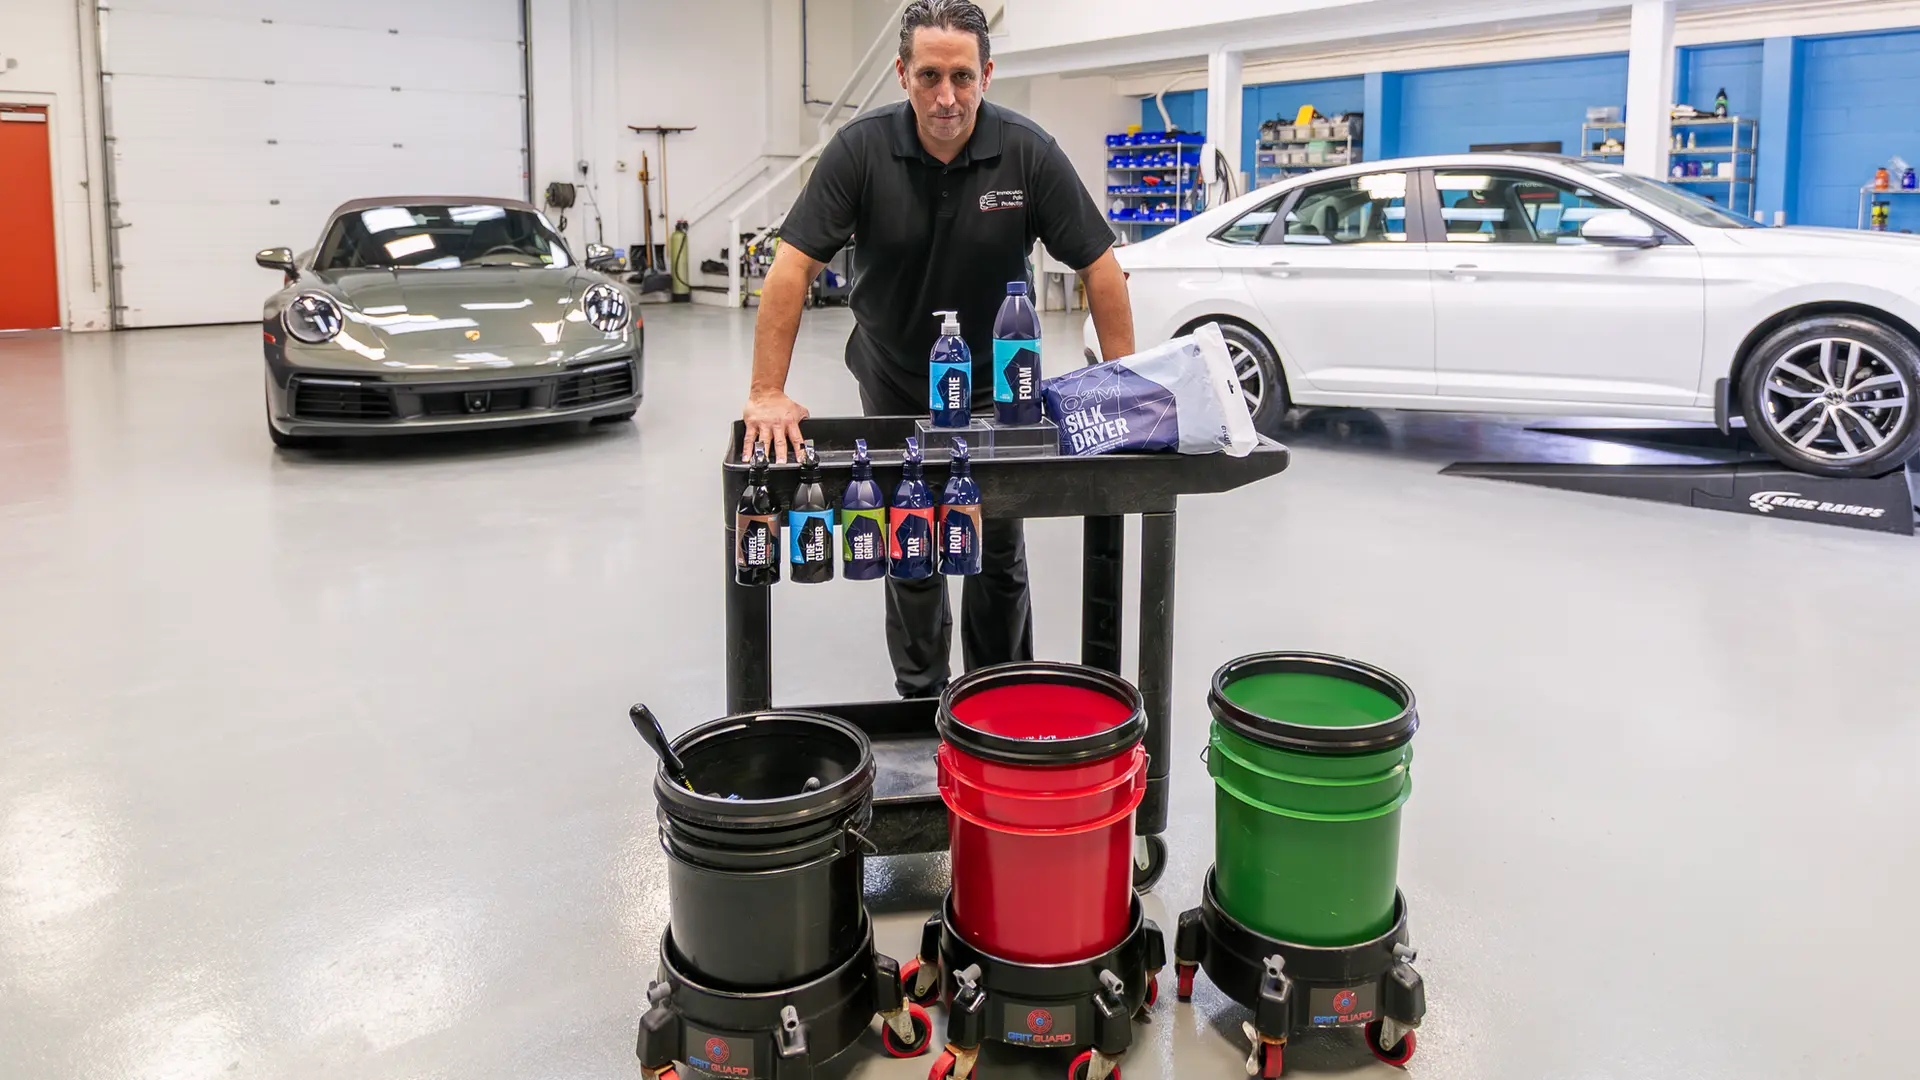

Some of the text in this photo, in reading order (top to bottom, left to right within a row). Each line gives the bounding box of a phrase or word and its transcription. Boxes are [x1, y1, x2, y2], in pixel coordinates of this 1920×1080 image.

[949, 376, 960, 409] BATHE
[1019, 367, 1032, 400] FOAM
[1065, 404, 1106, 434] SILK
[1071, 417, 1130, 453] DRYER
[1770, 496, 1886, 518] RACE RAMPS
[748, 536, 757, 560] WHEEL
[757, 528, 766, 560] CLEANER
[806, 542, 815, 562] TIRE
[815, 525, 824, 561] CLEANER
[863, 532, 873, 560] GRIME
[907, 537, 920, 559] TAR
[949, 526, 962, 554] IRON
[1313, 1010, 1373, 1024] GRIT GUARD
[1007, 1031, 1072, 1043] GRIT GUARD
[689, 1056, 749, 1076] GRIT GUARD
